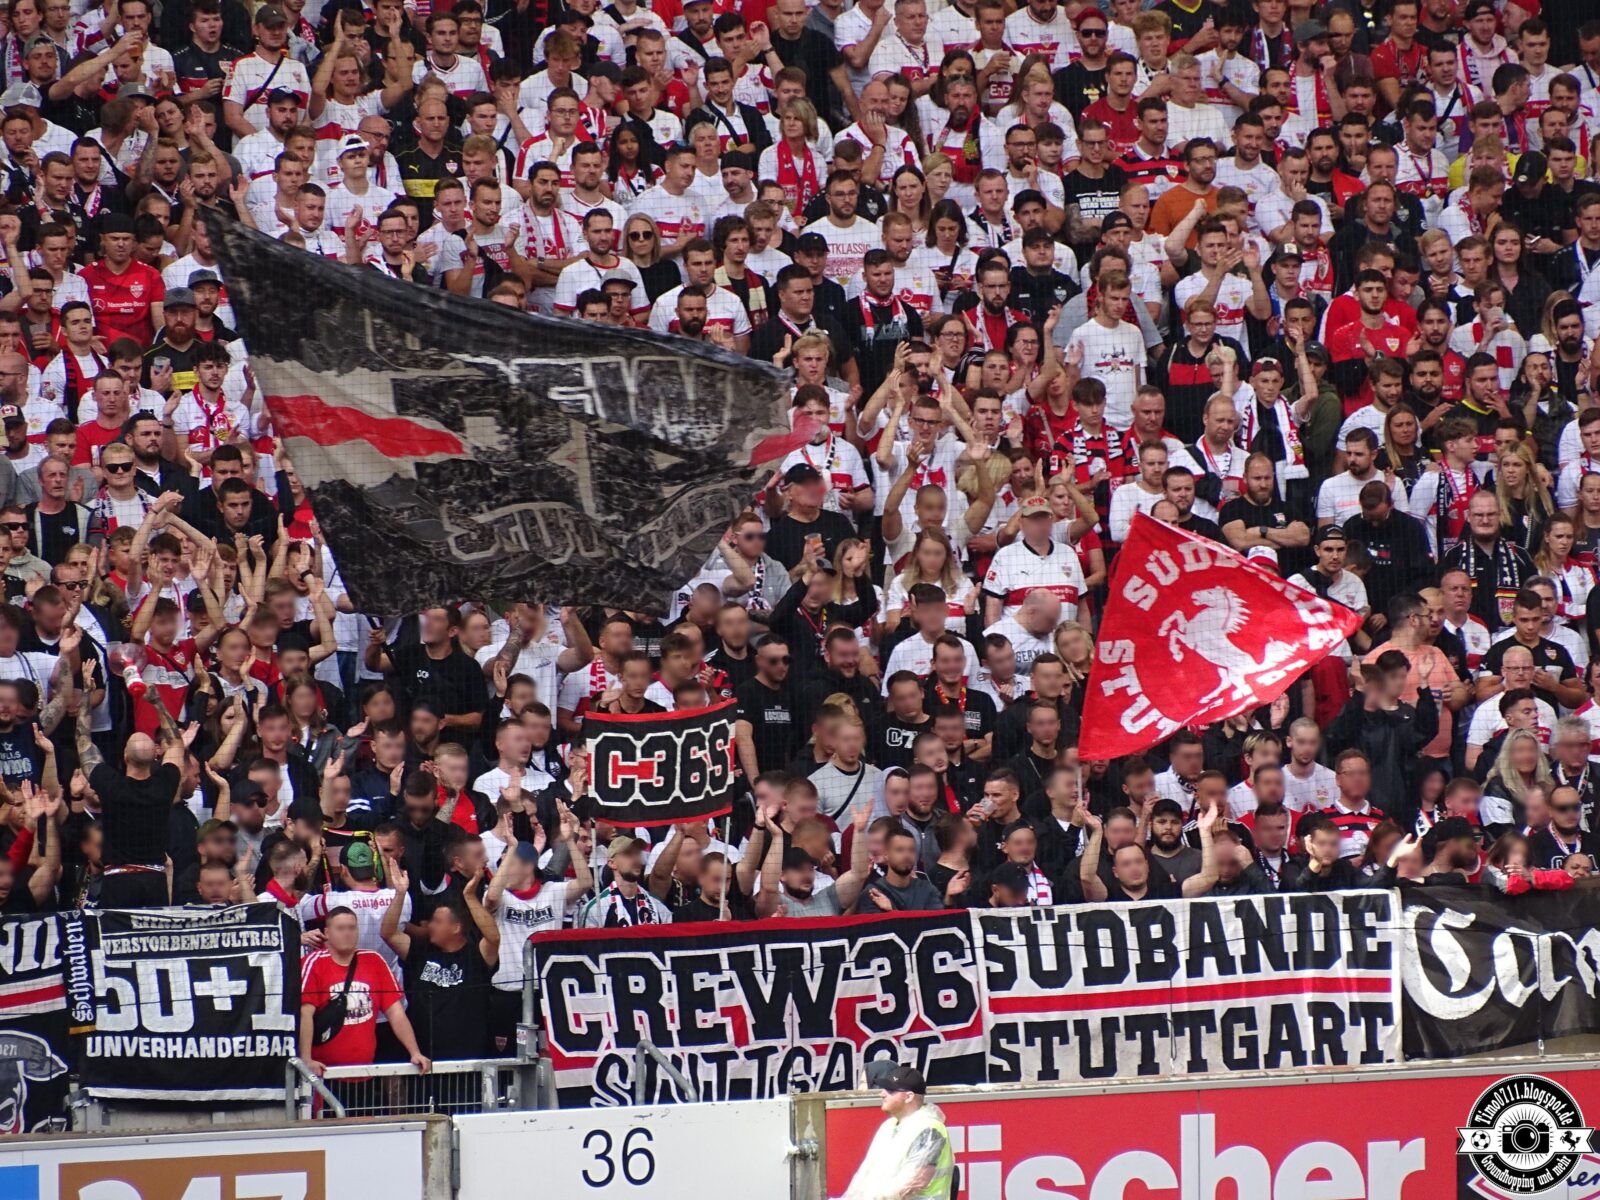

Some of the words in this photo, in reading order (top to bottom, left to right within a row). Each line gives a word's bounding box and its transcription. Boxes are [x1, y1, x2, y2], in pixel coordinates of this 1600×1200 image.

[594, 719, 731, 807] C36S
[102, 932, 220, 956] VERSTORBENEN
[221, 929, 281, 948] ULTRAS
[979, 894, 1392, 991] SÜDBANDE
[91, 950, 295, 1033] 50+1
[86, 1035, 296, 1059] UNVERHANDELBAR
[581, 1127, 656, 1188] 36
